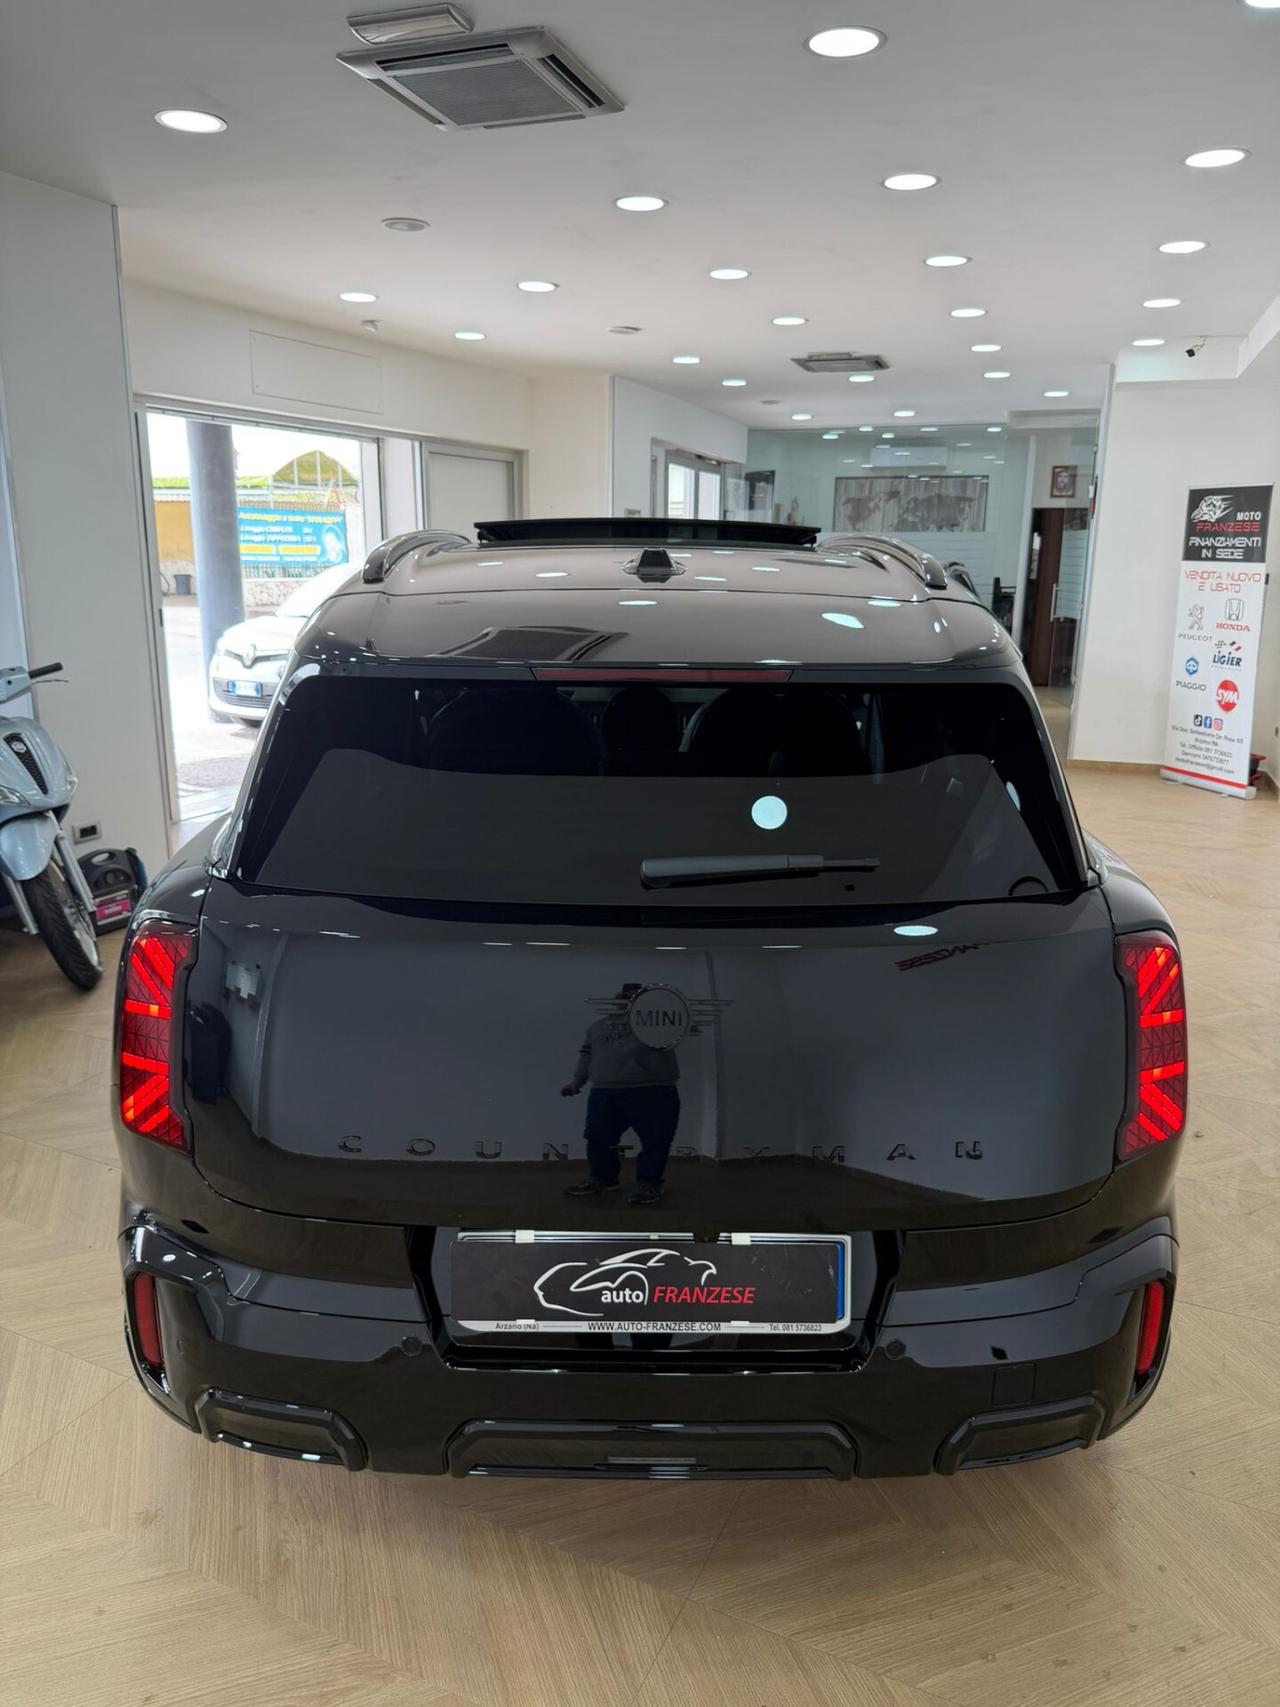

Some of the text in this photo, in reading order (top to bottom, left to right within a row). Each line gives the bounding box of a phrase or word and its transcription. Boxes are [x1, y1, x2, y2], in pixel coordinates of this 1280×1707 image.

[1236, 512, 1261, 520] MOTO
[1195, 522, 1260, 532] FRANZESE
[1201, 549, 1244, 559] IN SEDE
[1185, 571, 1261, 582] VENDITA NUOVO
[1198, 582, 1241, 594] E USATO
[1216, 623, 1250, 631] HONDA
[1178, 633, 1213, 642] PEUGEOT
[1176, 680, 1207, 692] PIAGGIO
[636, 1009, 682, 1027] MINI
[337, 1135, 984, 1164] COUNTRYMAN
[601, 1286, 756, 1304] auto FRANZESE
[495, 1321, 522, 1331] Arzano
[587, 1321, 722, 1332] WWW.AUTO-FRANZESE.COM
[782, 1323, 794, 1332] 081
